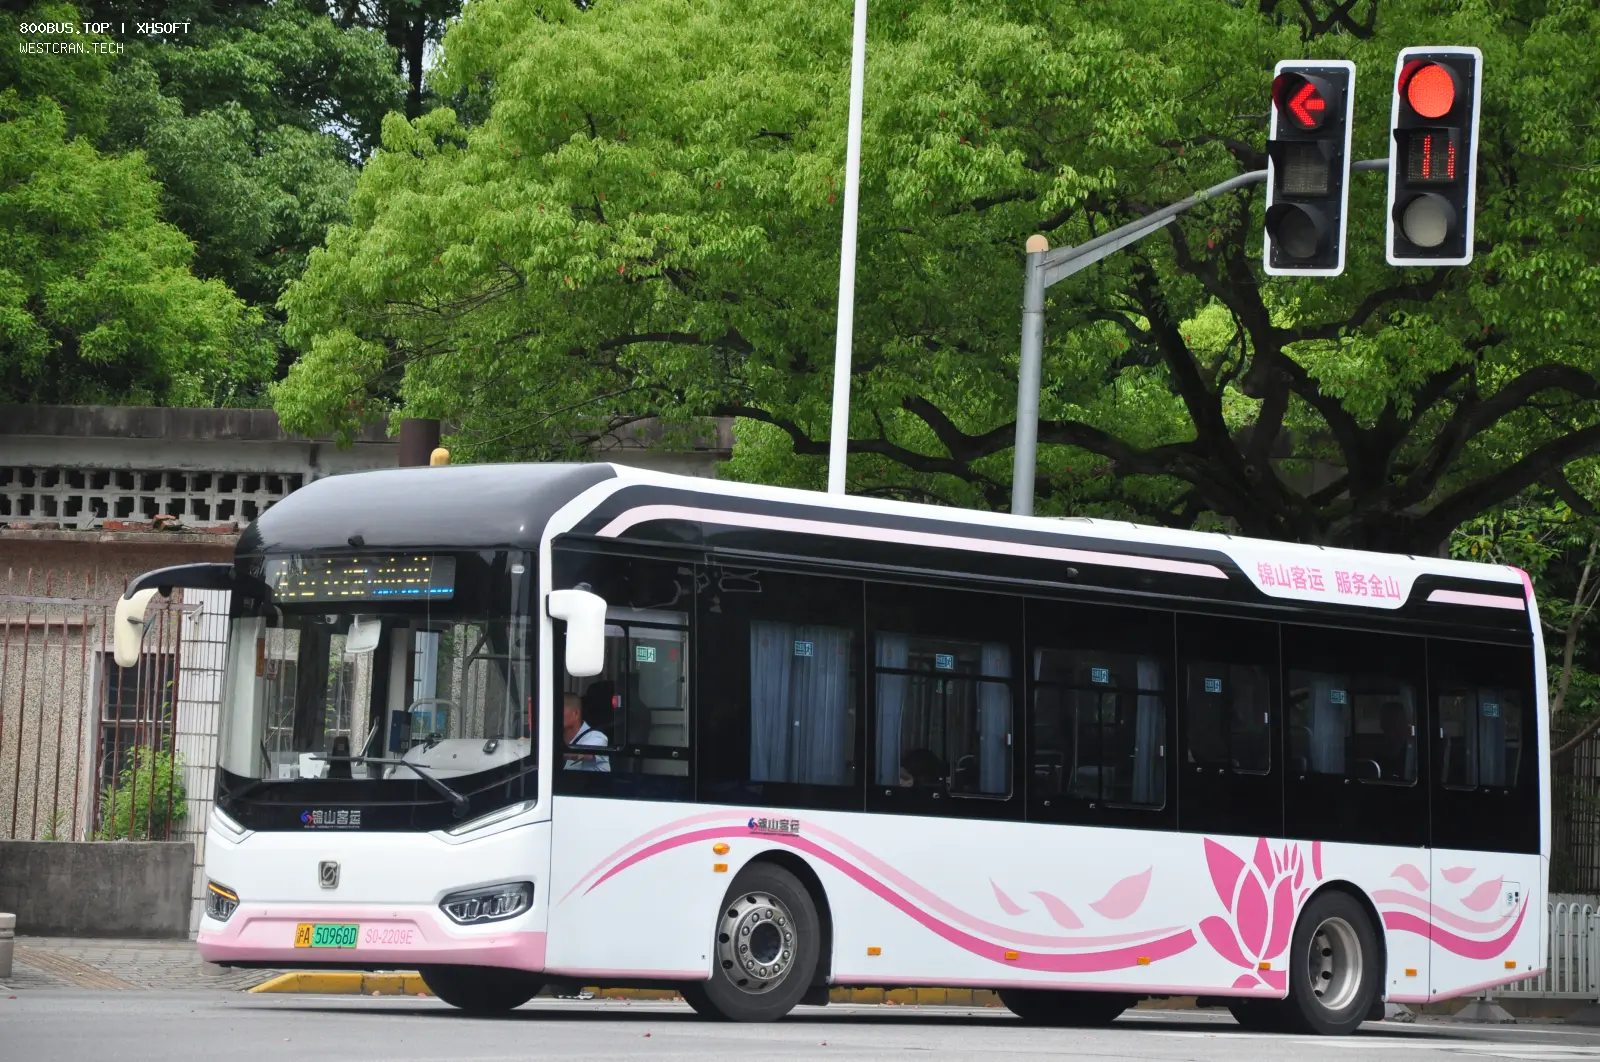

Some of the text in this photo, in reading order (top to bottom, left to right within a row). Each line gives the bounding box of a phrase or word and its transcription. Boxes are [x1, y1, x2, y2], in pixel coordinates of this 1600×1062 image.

[1422, 135, 1455, 179] 11
[1257, 562, 1401, 600] 锦山客运 服务金山
